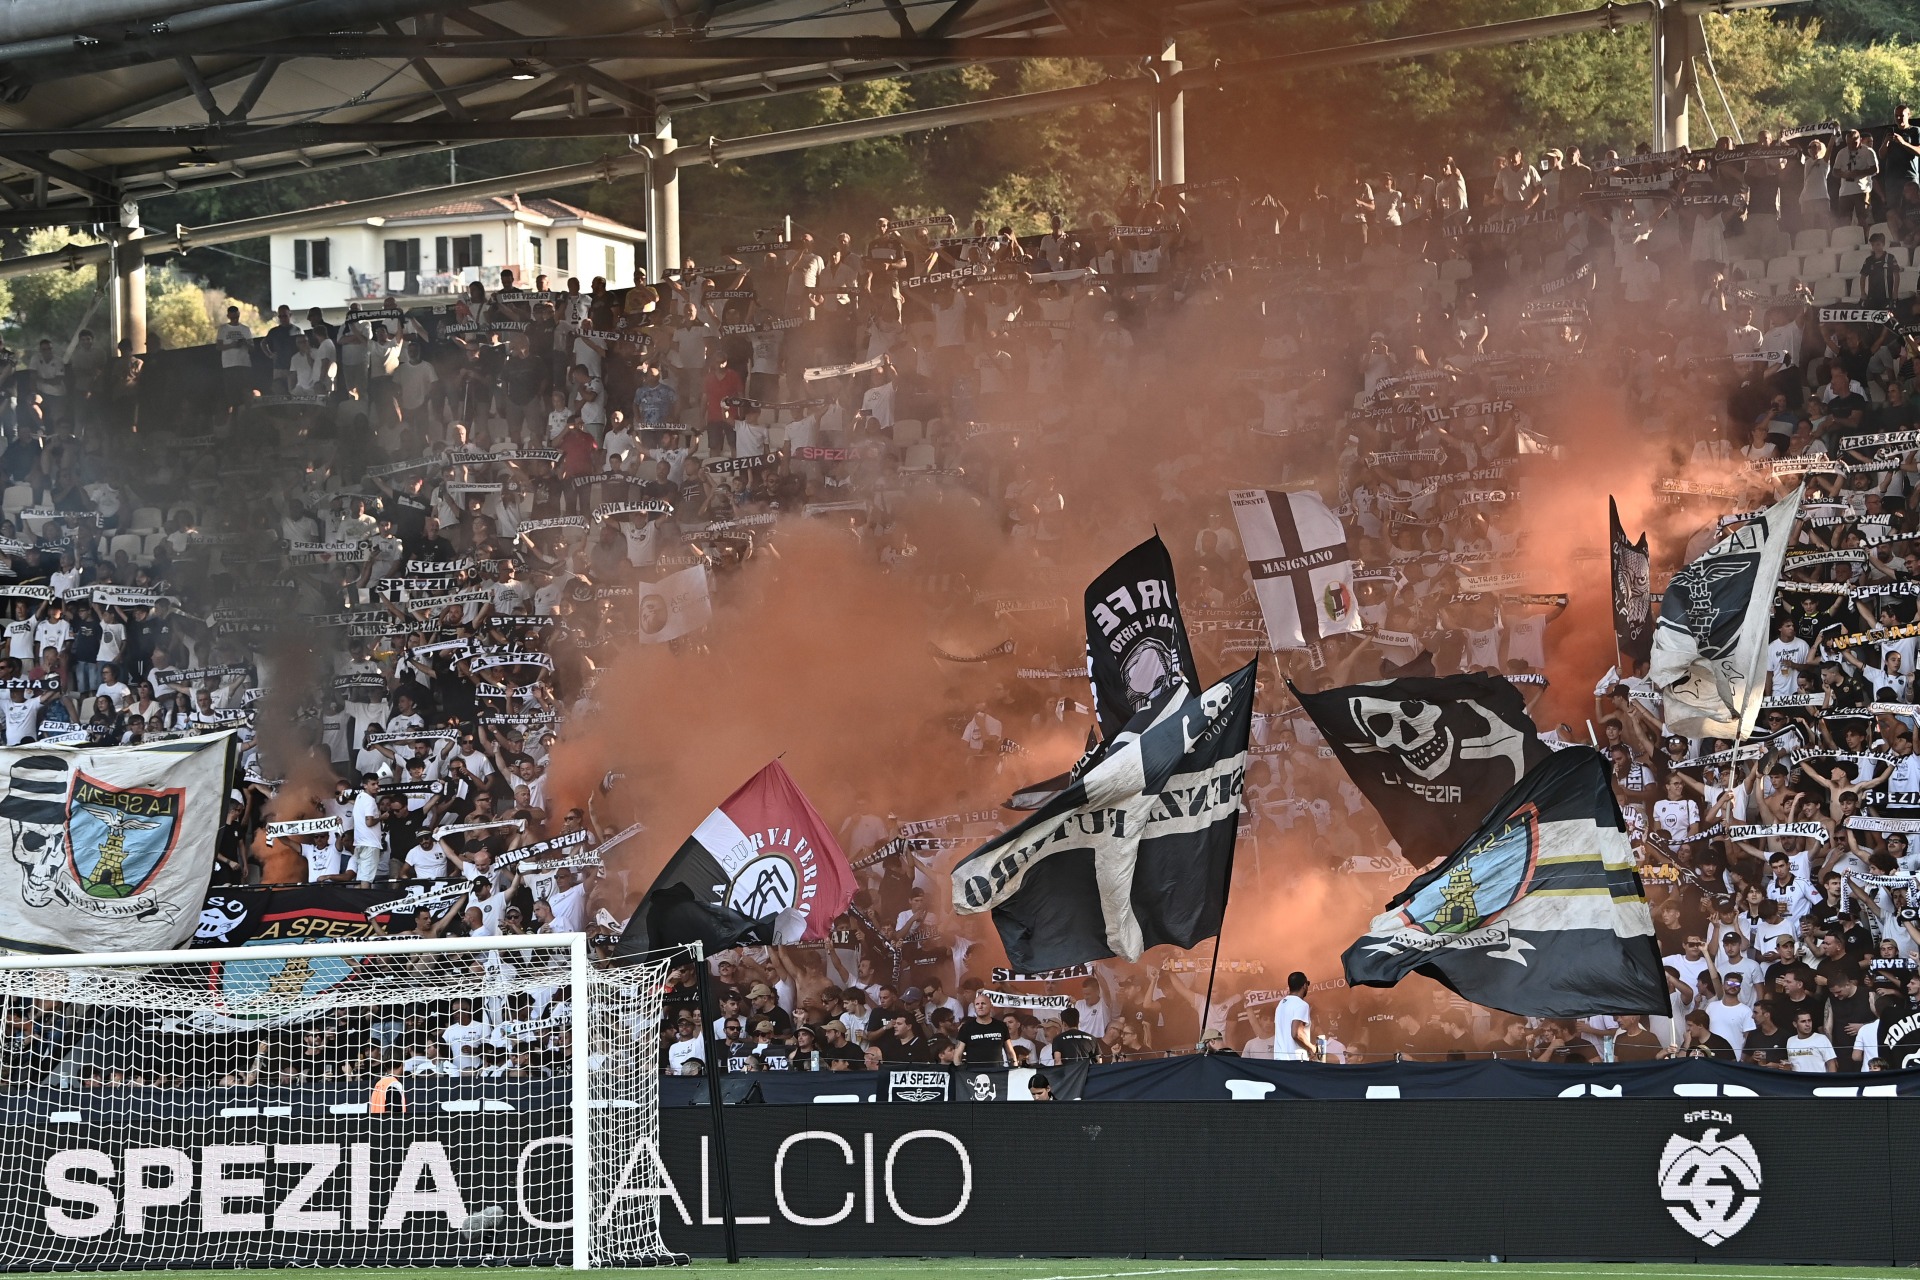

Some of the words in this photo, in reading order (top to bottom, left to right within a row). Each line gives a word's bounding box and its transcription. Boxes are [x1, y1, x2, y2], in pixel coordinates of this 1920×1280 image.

[1682, 194, 1733, 206] PEZIA
[1822, 310, 1870, 321] SINCE
[722, 323, 757, 336] SPEZIA
[771, 317, 805, 331] GROUP
[622, 333, 652, 346] 1906
[1364, 406, 1393, 419] Spezia
[1396, 402, 1414, 414] Old
[1426, 404, 1461, 423] ULT
[1480, 400, 1515, 415] RAS
[1841, 434, 1876, 450] SPEZI
[453, 453, 498, 464] ORGOGLIO
[802, 447, 861, 461] SPEZIA
[715, 457, 763, 473] SPEZIA
[1423, 472, 1454, 487] LTRAS
[1859, 513, 1892, 526] SPEZIA
[294, 541, 324, 550] SPEZIA
[324, 542, 356, 550] CALCIO
[335, 550, 366, 562] CUORE
[1261, 549, 1334, 575] MASIGNANO
[1805, 552, 1835, 565] DURA
[1836, 550, 1848, 561] LA
[1848, 549, 1867, 559] VIN
[410, 558, 467, 573] SPEZIA
[1358, 569, 1382, 577] 1906
[376, 578, 459, 592] SPEZIA
[1466, 575, 1499, 584] ULTRAS
[1500, 571, 1530, 582] SPEZI
[64, 586, 94, 599] ULTRA
[114, 586, 152, 596] SPEZIA
[1848, 582, 1911, 600] SPEZIA
[117, 596, 134, 604] Non
[134, 597, 155, 605] siete
[410, 597, 443, 611] FORZA
[454, 591, 490, 604] SPEZIA
[490, 616, 555, 626] SPEZIA
[1190, 618, 1268, 635] SPEZI
[471, 656, 489, 671] LA
[500, 653, 553, 669] SPEZIA
[214, 708, 243, 721] SPE
[535, 710, 556, 718] COLLO
[1871, 702, 1915, 714] ORGOGLIO
[508, 717, 531, 726] CALDO
[1250, 743, 1292, 754] FERROV
[1406, 782, 1462, 804] EZIA
[901, 818, 943, 838] SINCE
[965, 809, 1000, 824] 1906
[549, 829, 588, 850] SPEZIA
[1728, 824, 1758, 840] URVA
[721, 827, 792, 874] CURVA
[893, 1072, 909, 1086] LA
[909, 1071, 947, 1087] SPEZIA
[1683, 1109, 1733, 1125] SPEZIA
[44, 1140, 470, 1239] SPEZIA
[516, 1129, 974, 1228] CALCIO
